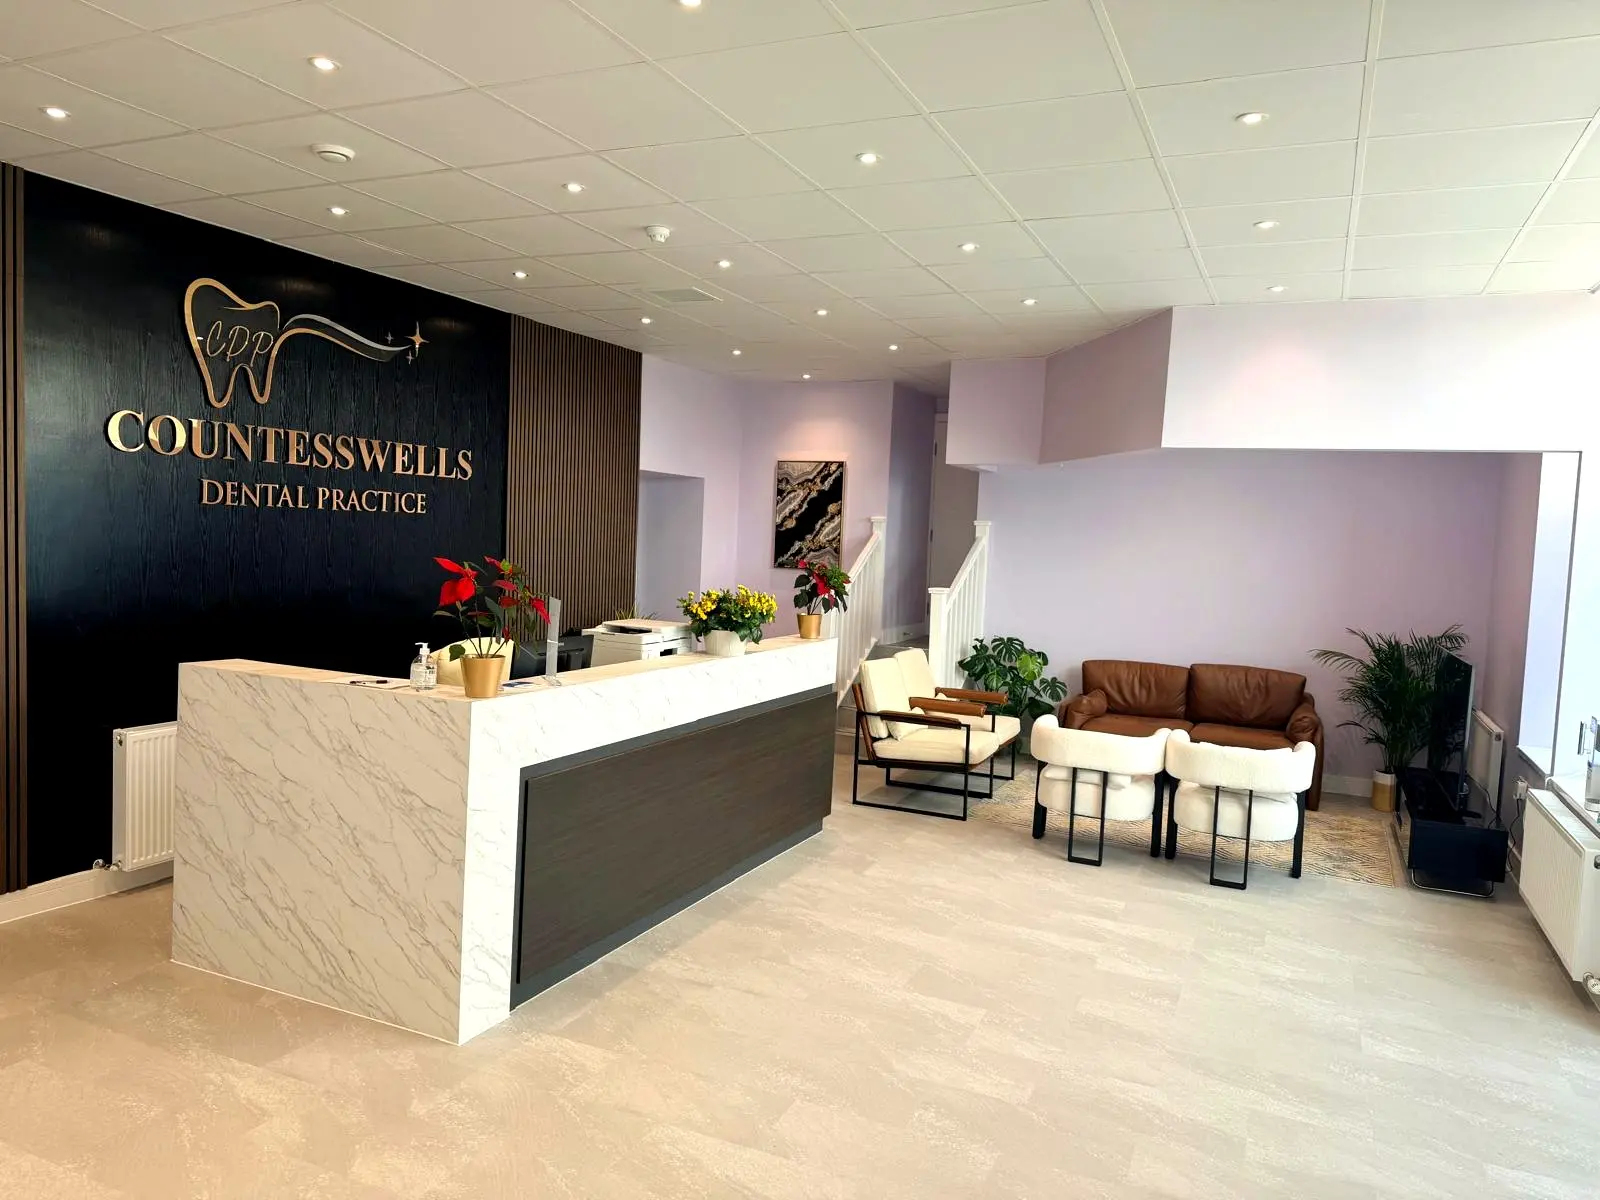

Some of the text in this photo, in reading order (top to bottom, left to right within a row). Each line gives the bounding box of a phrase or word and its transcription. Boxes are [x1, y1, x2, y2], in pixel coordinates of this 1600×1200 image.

[205, 320, 274, 367] CDP
[107, 409, 473, 481] COUNTESSWELLS
[201, 479, 427, 514] DENTAL PRACTICE
